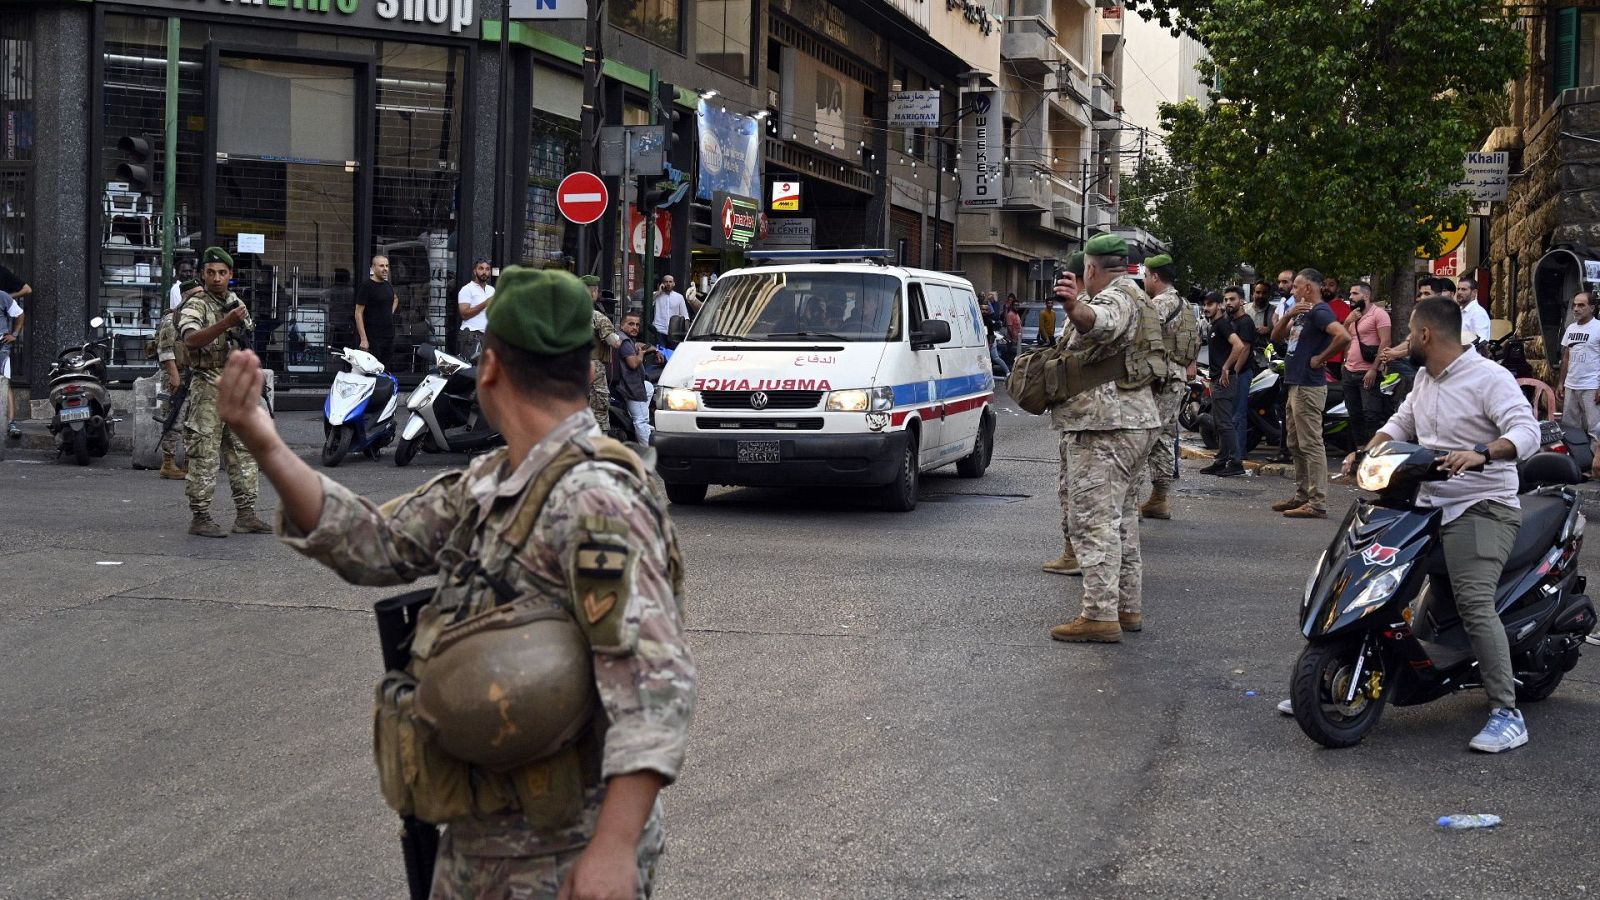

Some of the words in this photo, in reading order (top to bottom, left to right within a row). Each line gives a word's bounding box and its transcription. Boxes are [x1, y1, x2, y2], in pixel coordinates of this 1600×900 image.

[1468, 153, 1505, 164] Khalil
[1467, 167, 1504, 175] Gynecology
[778, 226, 809, 234] CENTER
[1435, 266, 1454, 276] alfa
[1567, 332, 1590, 342] PUMA
[794, 355, 836, 367] الدفاع
